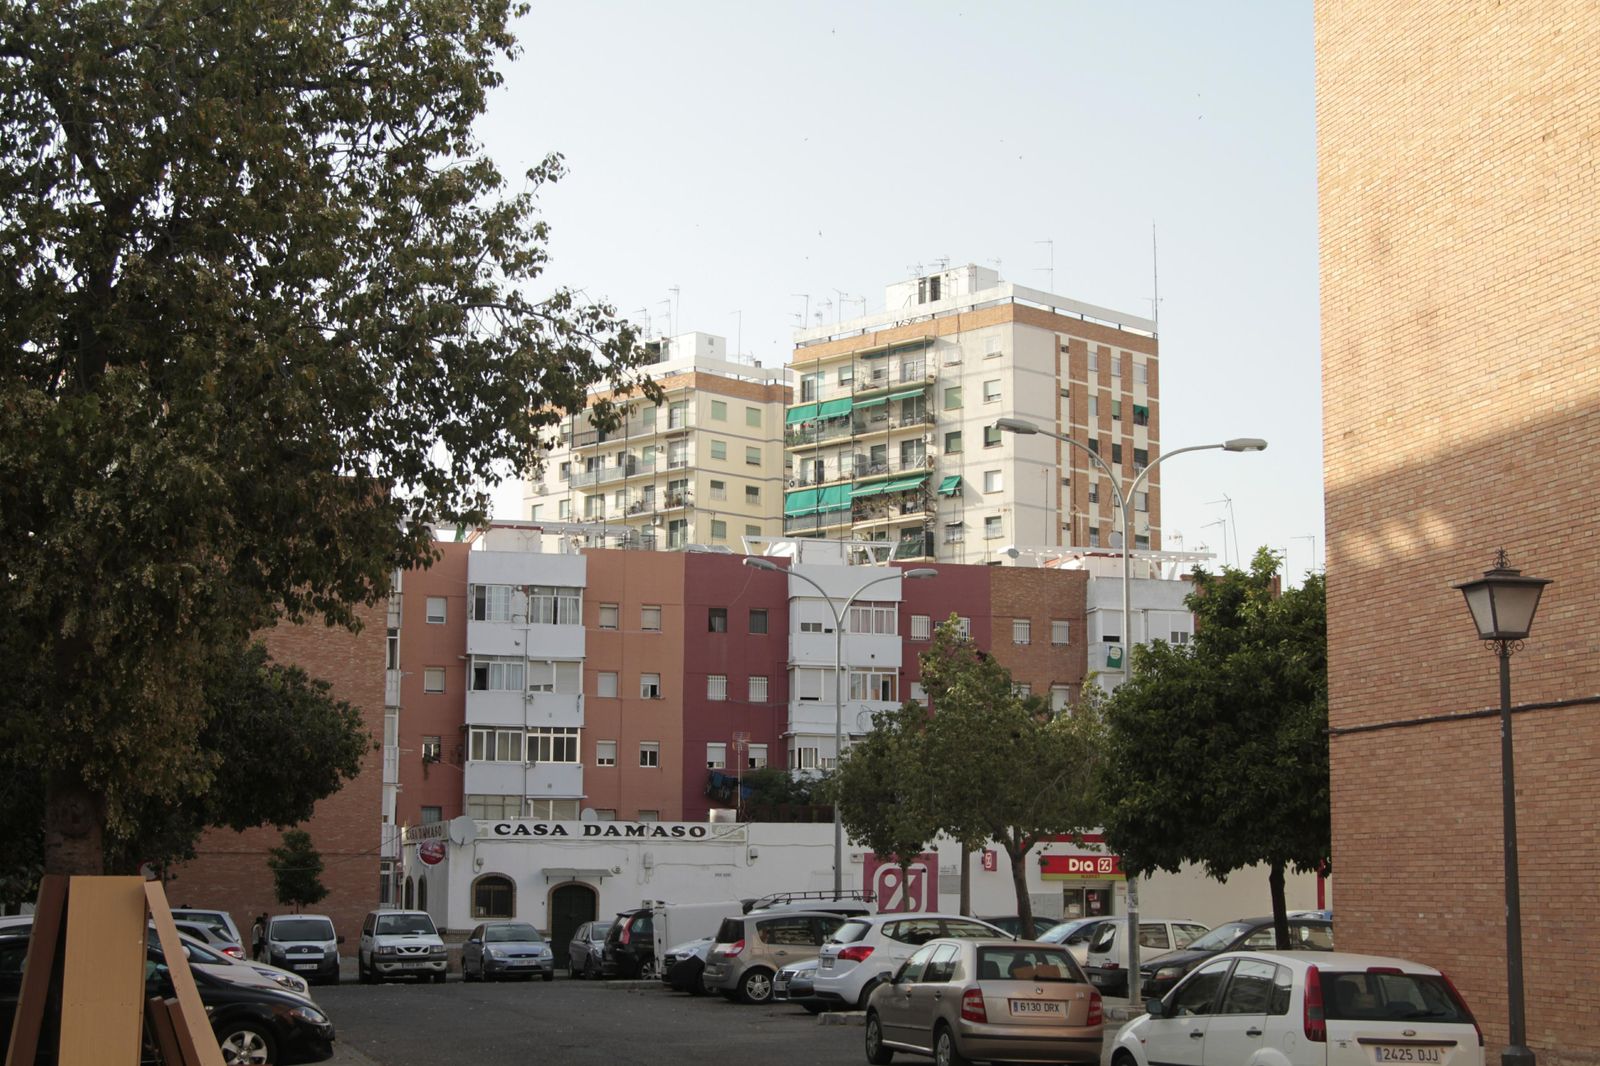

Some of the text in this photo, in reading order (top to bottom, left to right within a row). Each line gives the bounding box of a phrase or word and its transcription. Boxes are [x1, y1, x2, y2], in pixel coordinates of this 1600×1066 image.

[494, 823, 568, 836] CASA
[583, 824, 706, 838] DAMASO
[1020, 1002, 1060, 1013] 6130 DRX
[1383, 1048, 1439, 1062] 2425 DJJ
